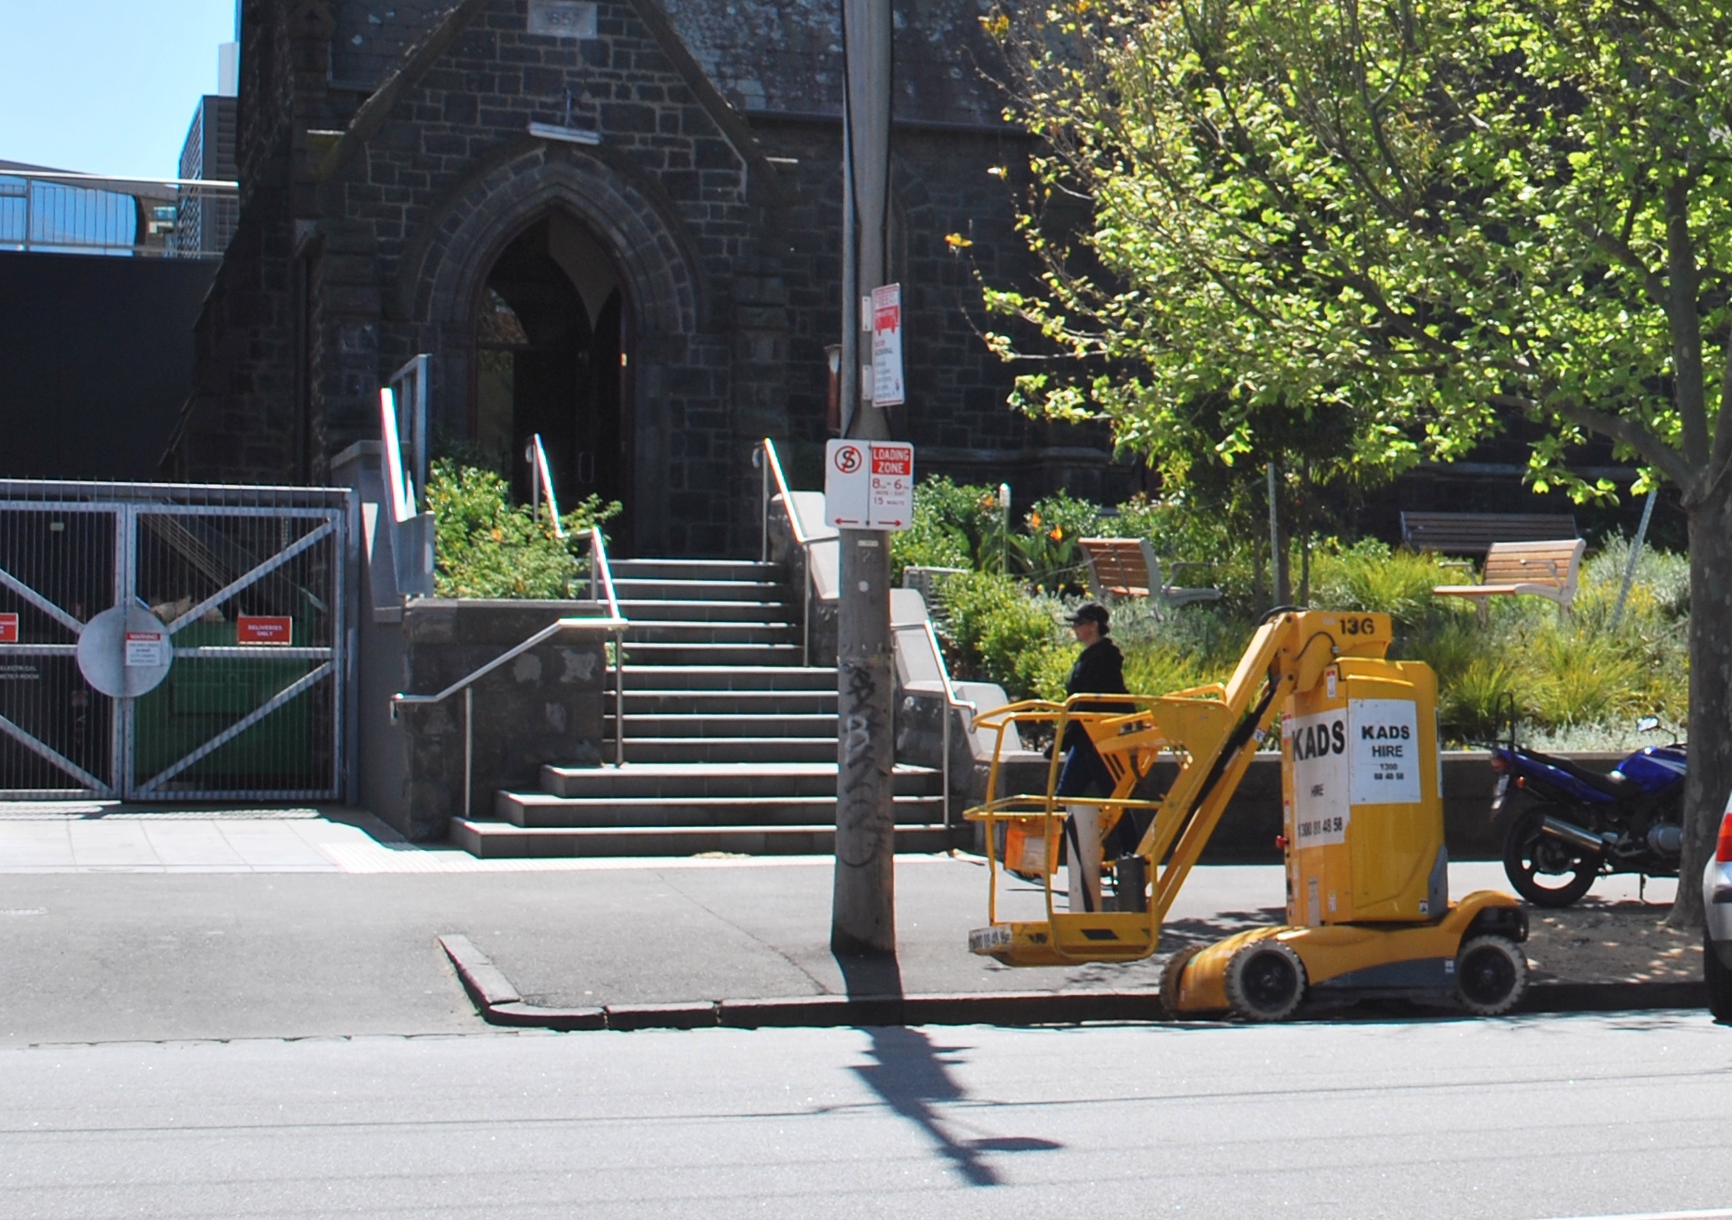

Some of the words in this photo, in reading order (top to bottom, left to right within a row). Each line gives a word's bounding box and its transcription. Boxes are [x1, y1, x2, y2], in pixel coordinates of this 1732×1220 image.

[873, 448, 910, 460] LOADING
[877, 461, 904, 474] ZONE
[874, 497, 884, 505] 15
[1361, 725, 1410, 740] KADS
[1292, 720, 1345, 762] KADS
[1371, 744, 1404, 758] HIRE
[1310, 783, 1324, 798] HIRE
